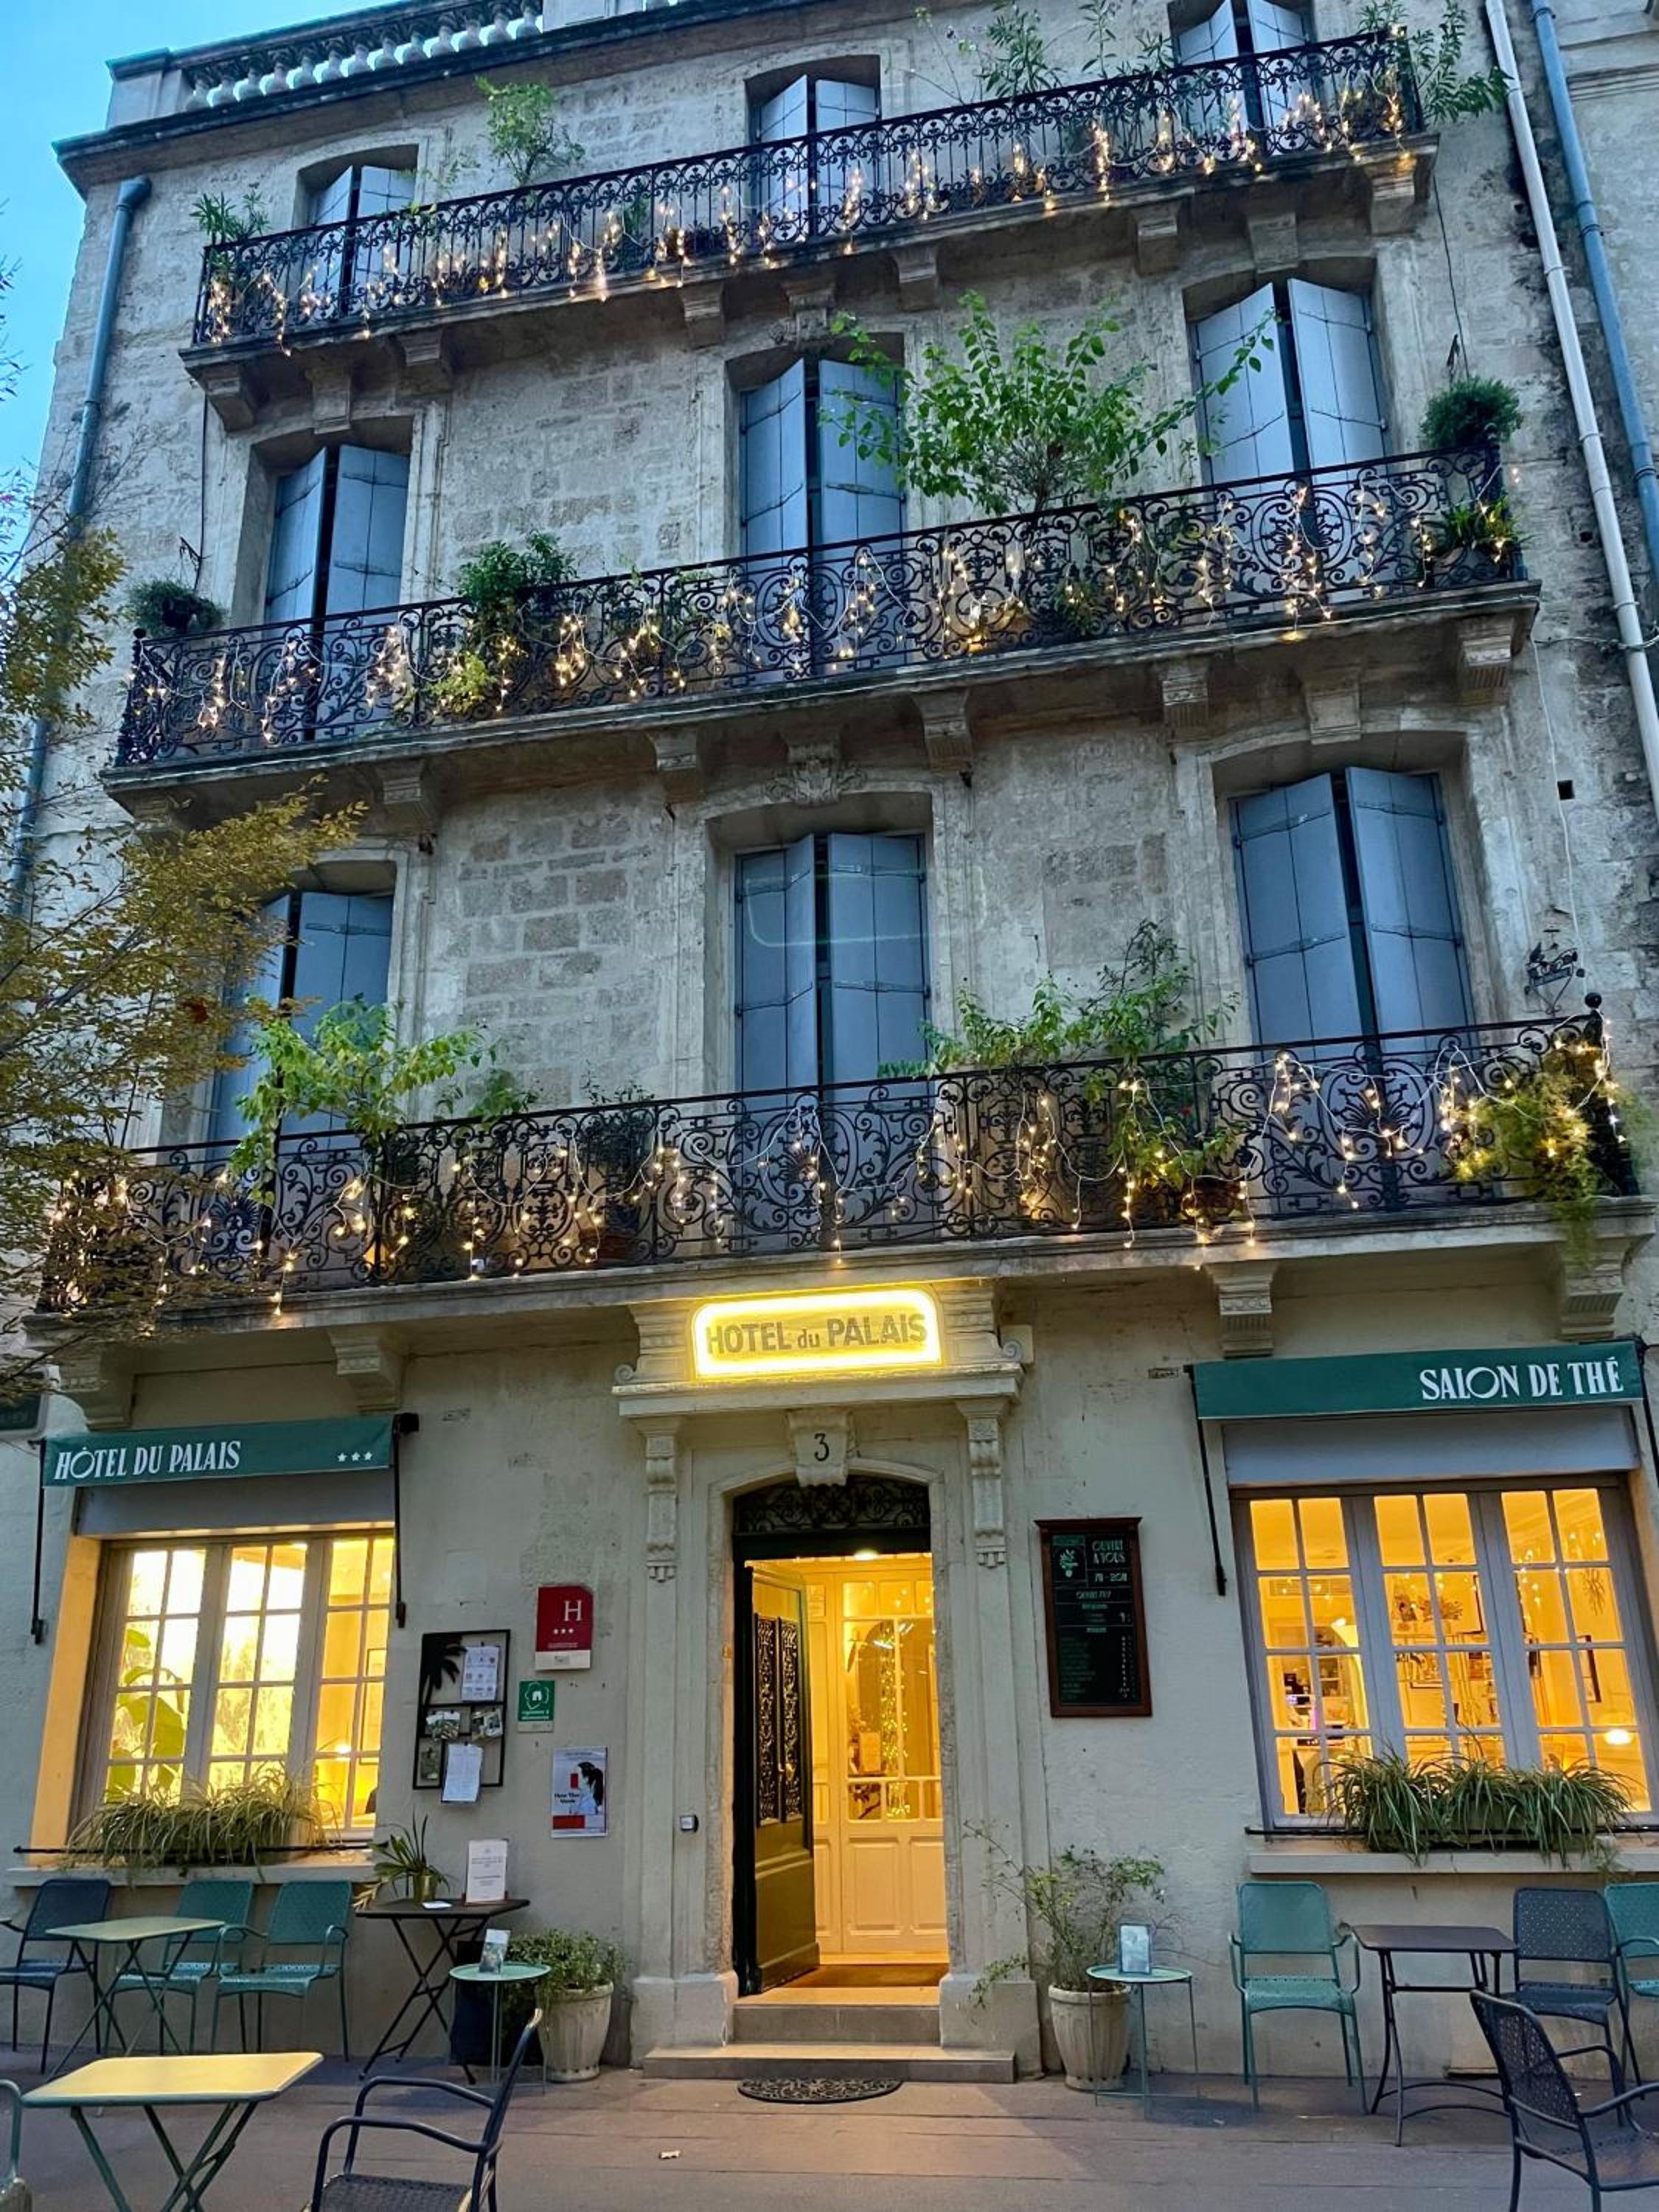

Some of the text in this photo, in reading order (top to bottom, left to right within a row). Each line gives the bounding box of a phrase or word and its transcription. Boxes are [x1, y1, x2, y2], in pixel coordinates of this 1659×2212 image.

[706, 1312, 927, 1355] HOTEL du PALAIS
[1419, 1356, 1624, 1400] SALON DE THÉ
[133, 1444, 164, 1475] DU
[169, 1440, 242, 1472] PALAIS
[813, 1433, 830, 1462] 3
[564, 1600, 582, 1621] H
